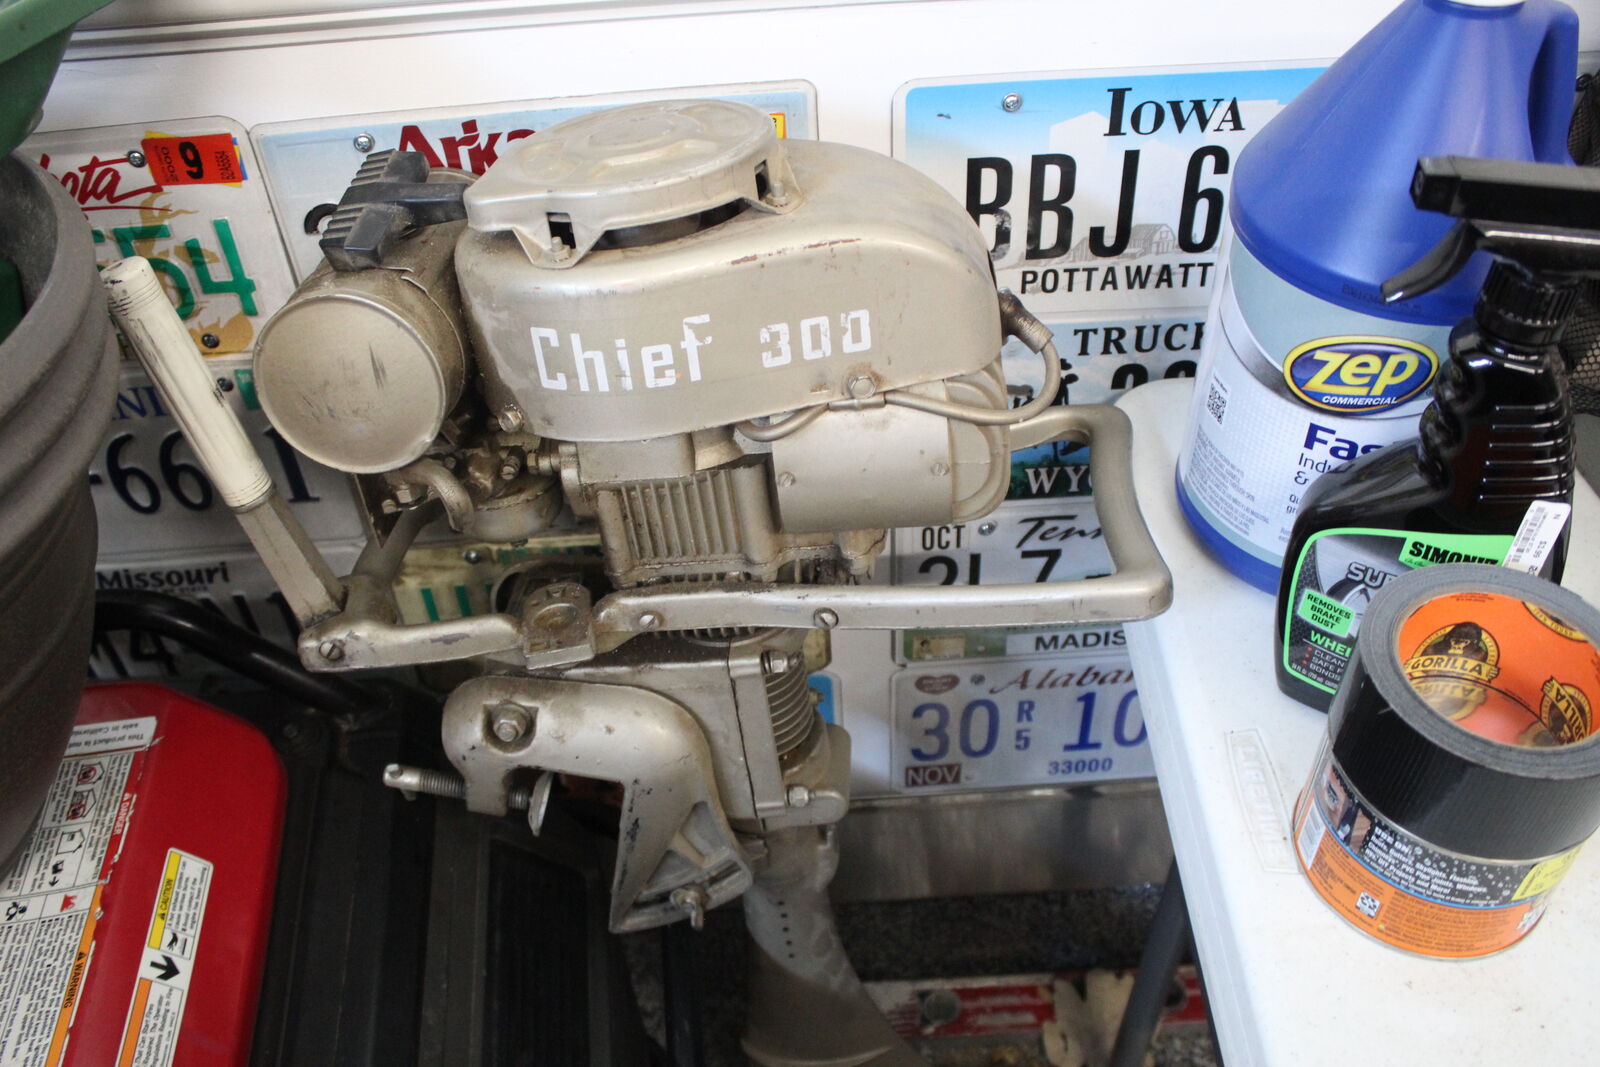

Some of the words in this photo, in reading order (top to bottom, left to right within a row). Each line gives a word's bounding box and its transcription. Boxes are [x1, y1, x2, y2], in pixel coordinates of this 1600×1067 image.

[39, 153, 164, 206] ota
[1020, 262, 1214, 294] POTTAWATT
[530, 314, 712, 392] Chief
[760, 309, 872, 368] 300
[1322, 395, 1398, 406] COMMERCIAL
[1298, 452, 1331, 474] Ind
[1025, 465, 1097, 496] WY
[922, 524, 966, 551] OCT
[97, 561, 230, 590] Missouri
[1346, 561, 1397, 589] SU
[1307, 594, 1351, 619] REMOVES
[1310, 605, 1342, 624] BRAKE
[1311, 614, 1336, 629] DUST
[1035, 629, 1126, 651] MADIS
[1315, 650, 1345, 667] CLEAN
[1411, 657, 1483, 676] GORILLA
[1017, 700, 1035, 723] R
[910, 699, 1000, 762] 30
[1015, 729, 1031, 750] 5
[907, 766, 960, 785] NOV
[1048, 758, 1113, 775] 33000
[159, 878, 173, 912] CAUTION
[64, 962, 83, 1009] WARNING
